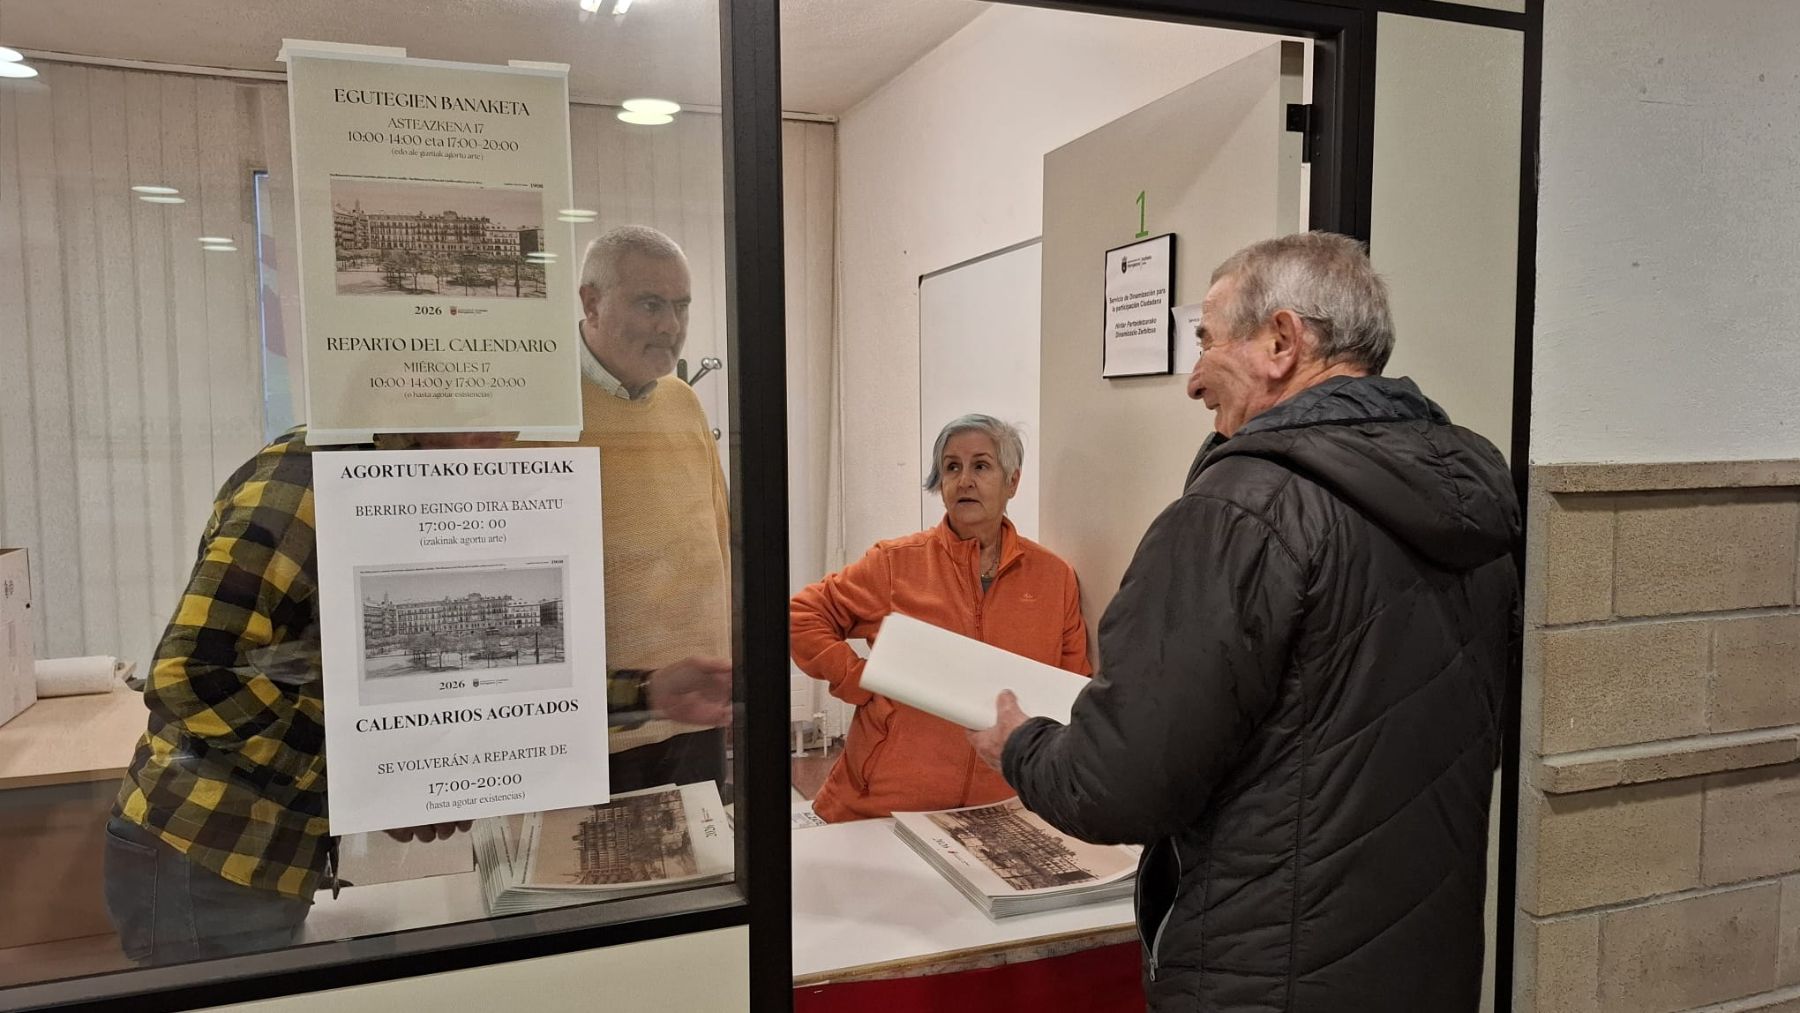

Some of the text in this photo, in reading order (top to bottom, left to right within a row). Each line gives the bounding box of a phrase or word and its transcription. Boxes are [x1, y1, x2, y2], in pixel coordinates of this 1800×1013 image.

[334, 88, 530, 116] EGUTEGIEN BANAKETA
[388, 117, 484, 134] ASTEAZKENA 17
[425, 137, 444, 148] eta
[1135, 190, 1149, 239] 1
[414, 305, 443, 316] 2026
[326, 337, 557, 353] REPARTO DEL CALENDARIO
[403, 360, 491, 373] MIÉRCOLES 17
[445, 380, 453, 389] y
[340, 460, 575, 479] AGORTUTAKO EGUTEGIAK
[355, 499, 563, 517] BERRIRO EGINGO DIRA BANATU
[419, 534, 507, 547] (izakinak agortu arte)
[439, 679, 466, 690] 2026
[355, 699, 579, 733] CALENDARIOS AGOTADOS
[378, 744, 567, 775] SE VOLVERÁN A REPARTIR DE
[428, 773, 522, 796] 17:00-20:00
[425, 791, 526, 811] (hasta agotar existencias)
